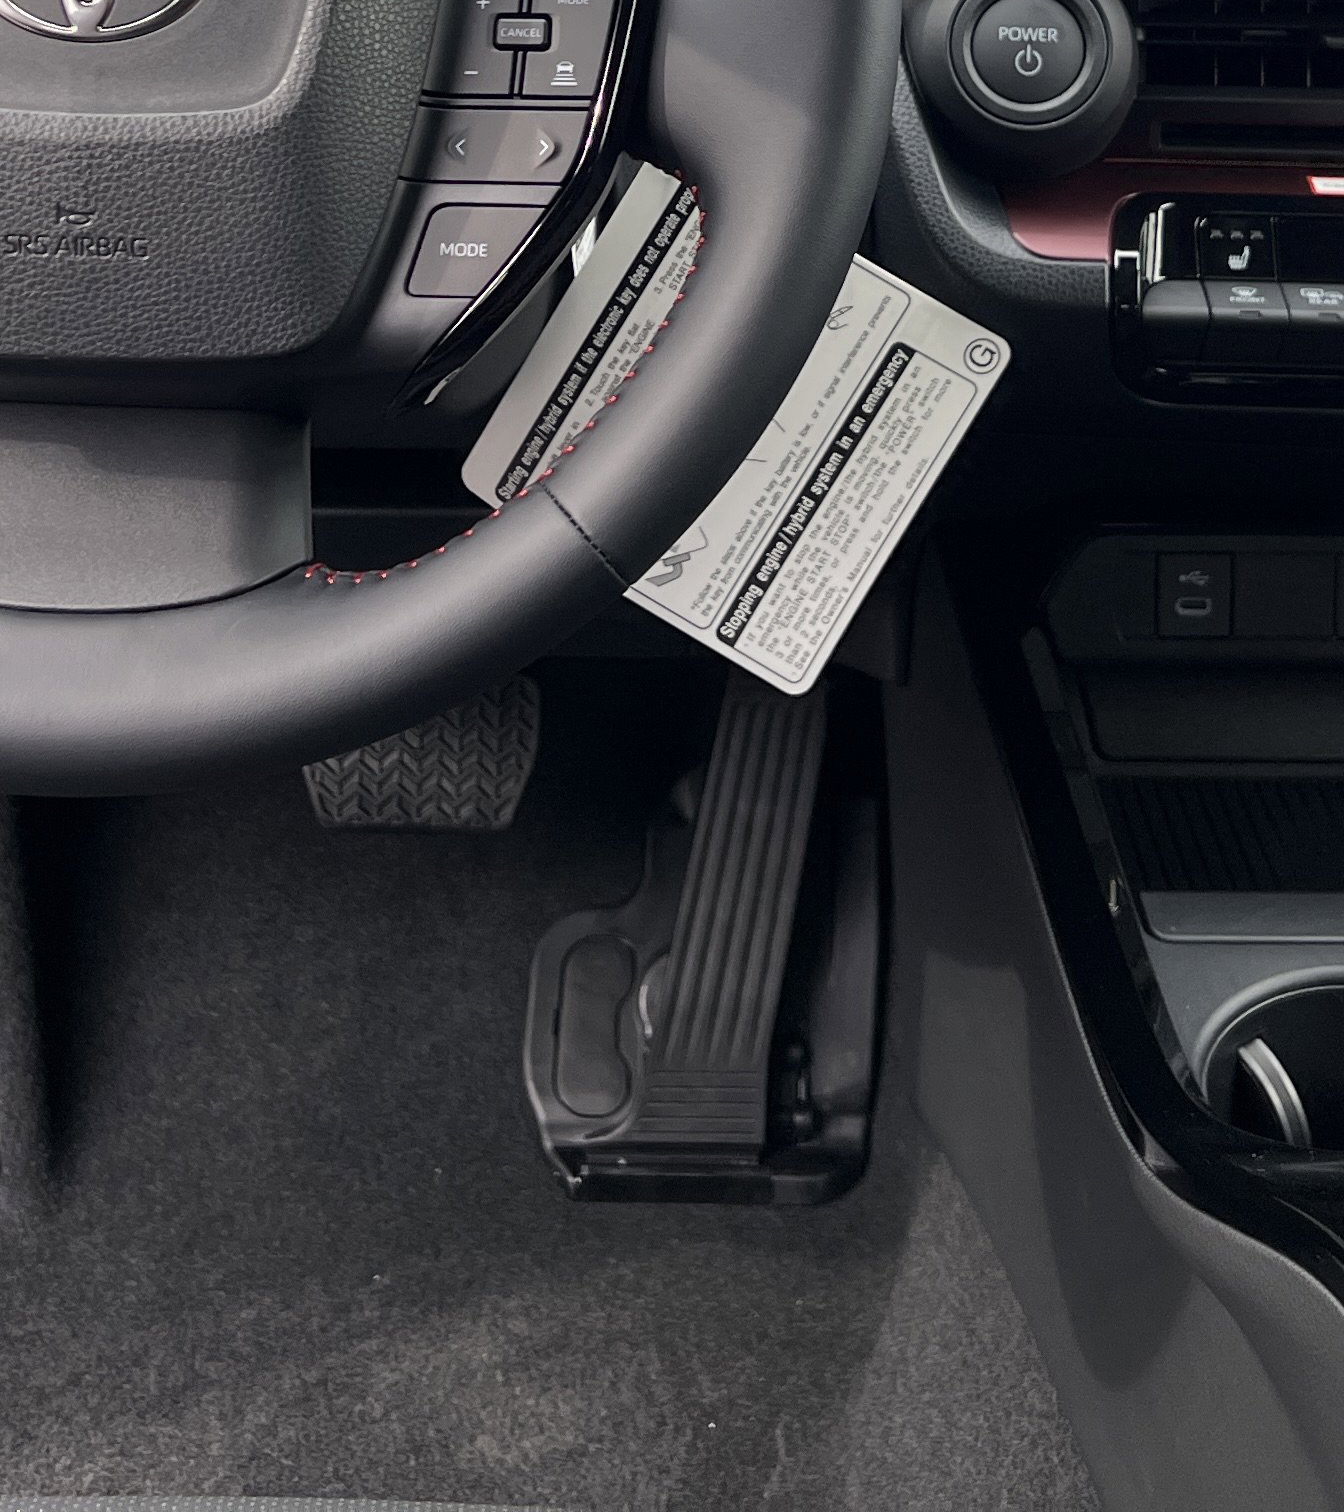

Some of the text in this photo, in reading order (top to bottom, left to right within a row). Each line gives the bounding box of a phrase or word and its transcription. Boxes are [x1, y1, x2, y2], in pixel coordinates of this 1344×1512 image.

[500, 27, 542, 39] CANCEL
[997, 25, 1058, 43] POWER
[674, 187, 699, 215] prop
[651, 211, 683, 248] operate
[3, 234, 150, 260] SRS AIRBAG
[439, 242, 488, 258] MODE
[641, 245, 660, 264] not
[626, 261, 650, 288] does
[616, 285, 637, 307] key
[589, 303, 624, 347] electronic
[574, 362, 587, 373] if
[579, 345, 598, 364] the
[969, 344, 996, 367] G
[554, 371, 585, 407] system
[497, 463, 529, 500] Starting
[718, 582, 764, 641] Stopping
[807, 449, 847, 497] system
[836, 433, 853, 449] in
[848, 414, 866, 434] an
[860, 348, 911, 416] emergency
[754, 610, 771, 630] you
[767, 582, 785, 605] want
[784, 567, 794, 578] to
[793, 543, 811, 565] stop
[808, 523, 822, 539] the
[877, 397, 903, 431] system
[756, 595, 793, 647] emergency
[807, 545, 821, 562] the
[820, 509, 844, 541] vehicle
[901, 385, 922, 413] press
[765, 636, 779, 652] the
[806, 551, 831, 584] START
[916, 376, 940, 407] switch
[792, 606, 810, 631] more
[839, 526, 860, 553] press
[858, 504, 873, 522] and
[888, 459, 901, 475] the
[900, 424, 923, 454] switch
[793, 649, 810, 670] See
[809, 629, 823, 645] the
[846, 546, 872, 581] Manual
